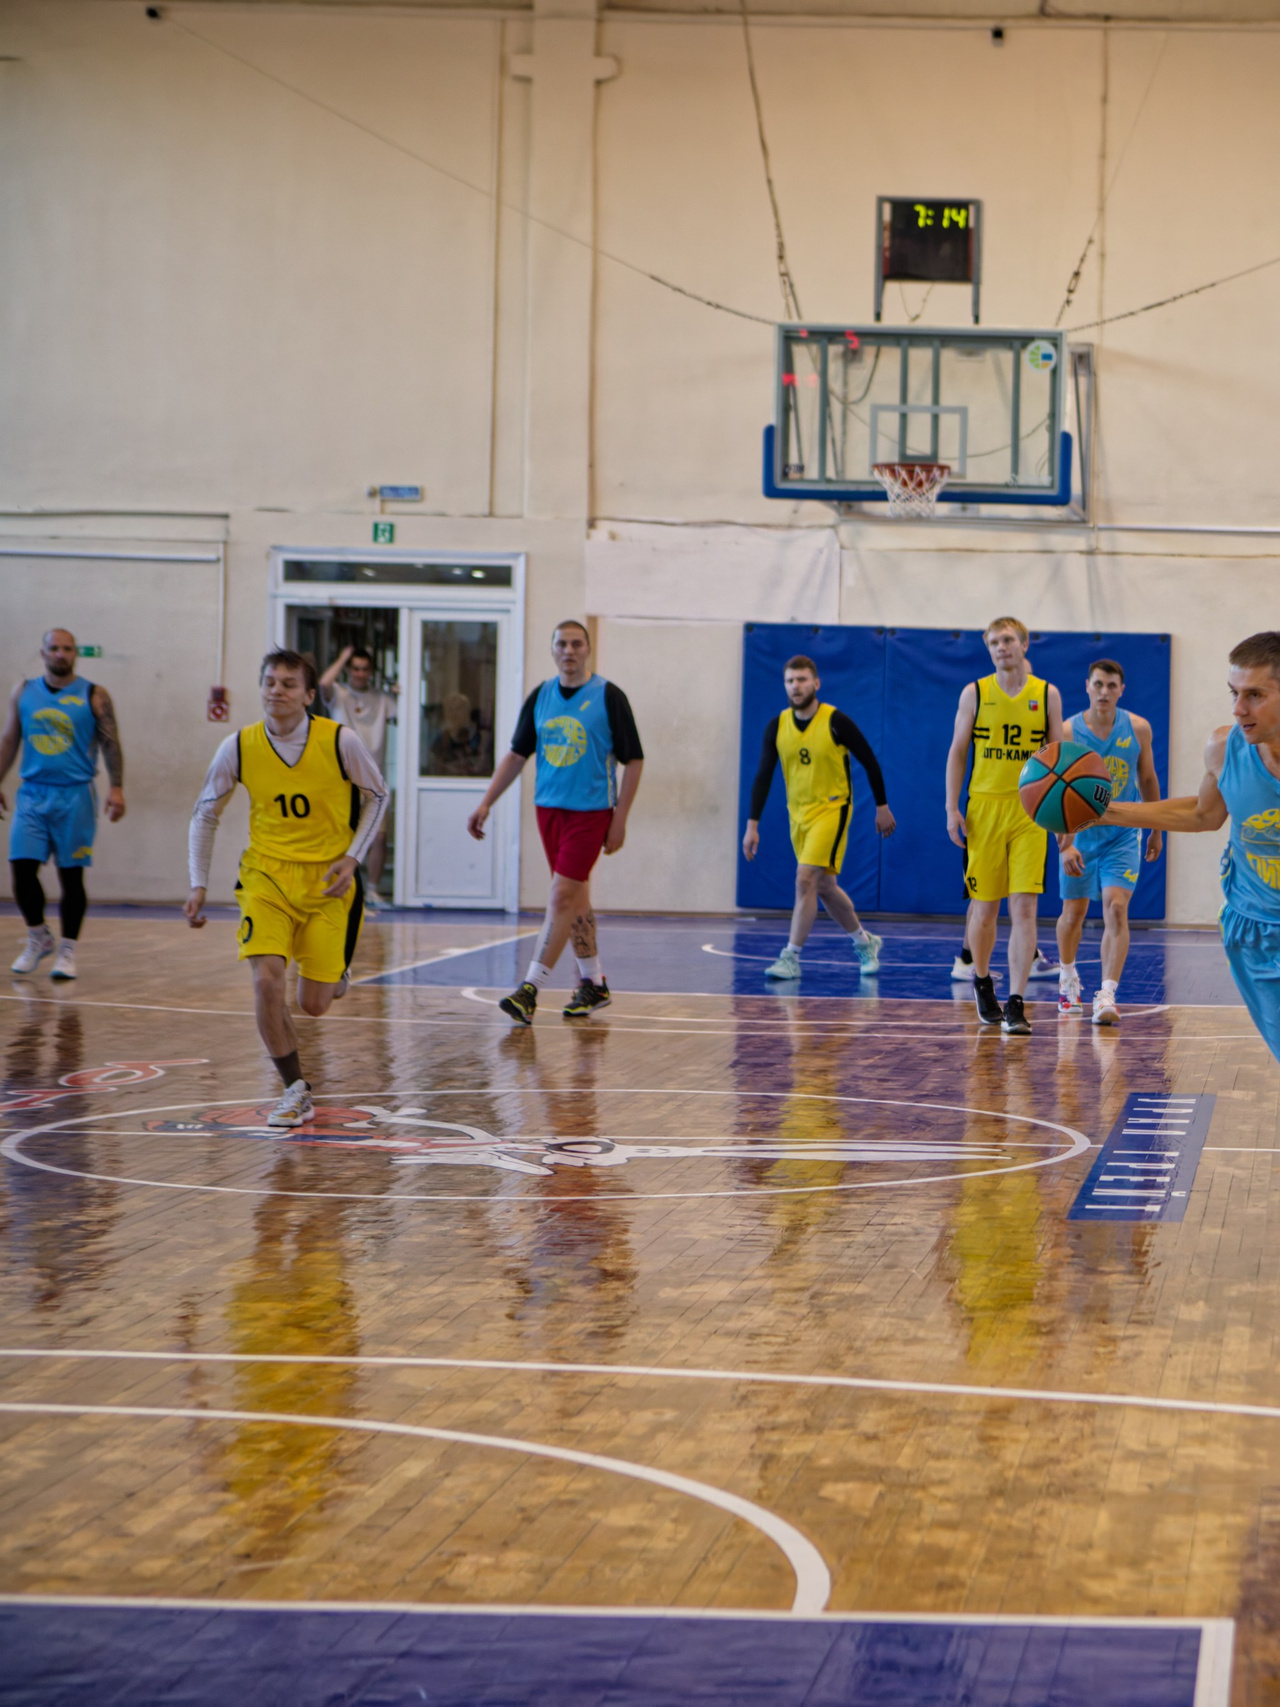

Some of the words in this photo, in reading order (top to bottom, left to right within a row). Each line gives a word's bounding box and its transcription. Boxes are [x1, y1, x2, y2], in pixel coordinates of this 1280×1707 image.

[914, 204, 967, 228] 7:14
[1002, 724, 1022, 746] 12
[799, 748, 811, 765] 8
[273, 793, 311, 819] 10
